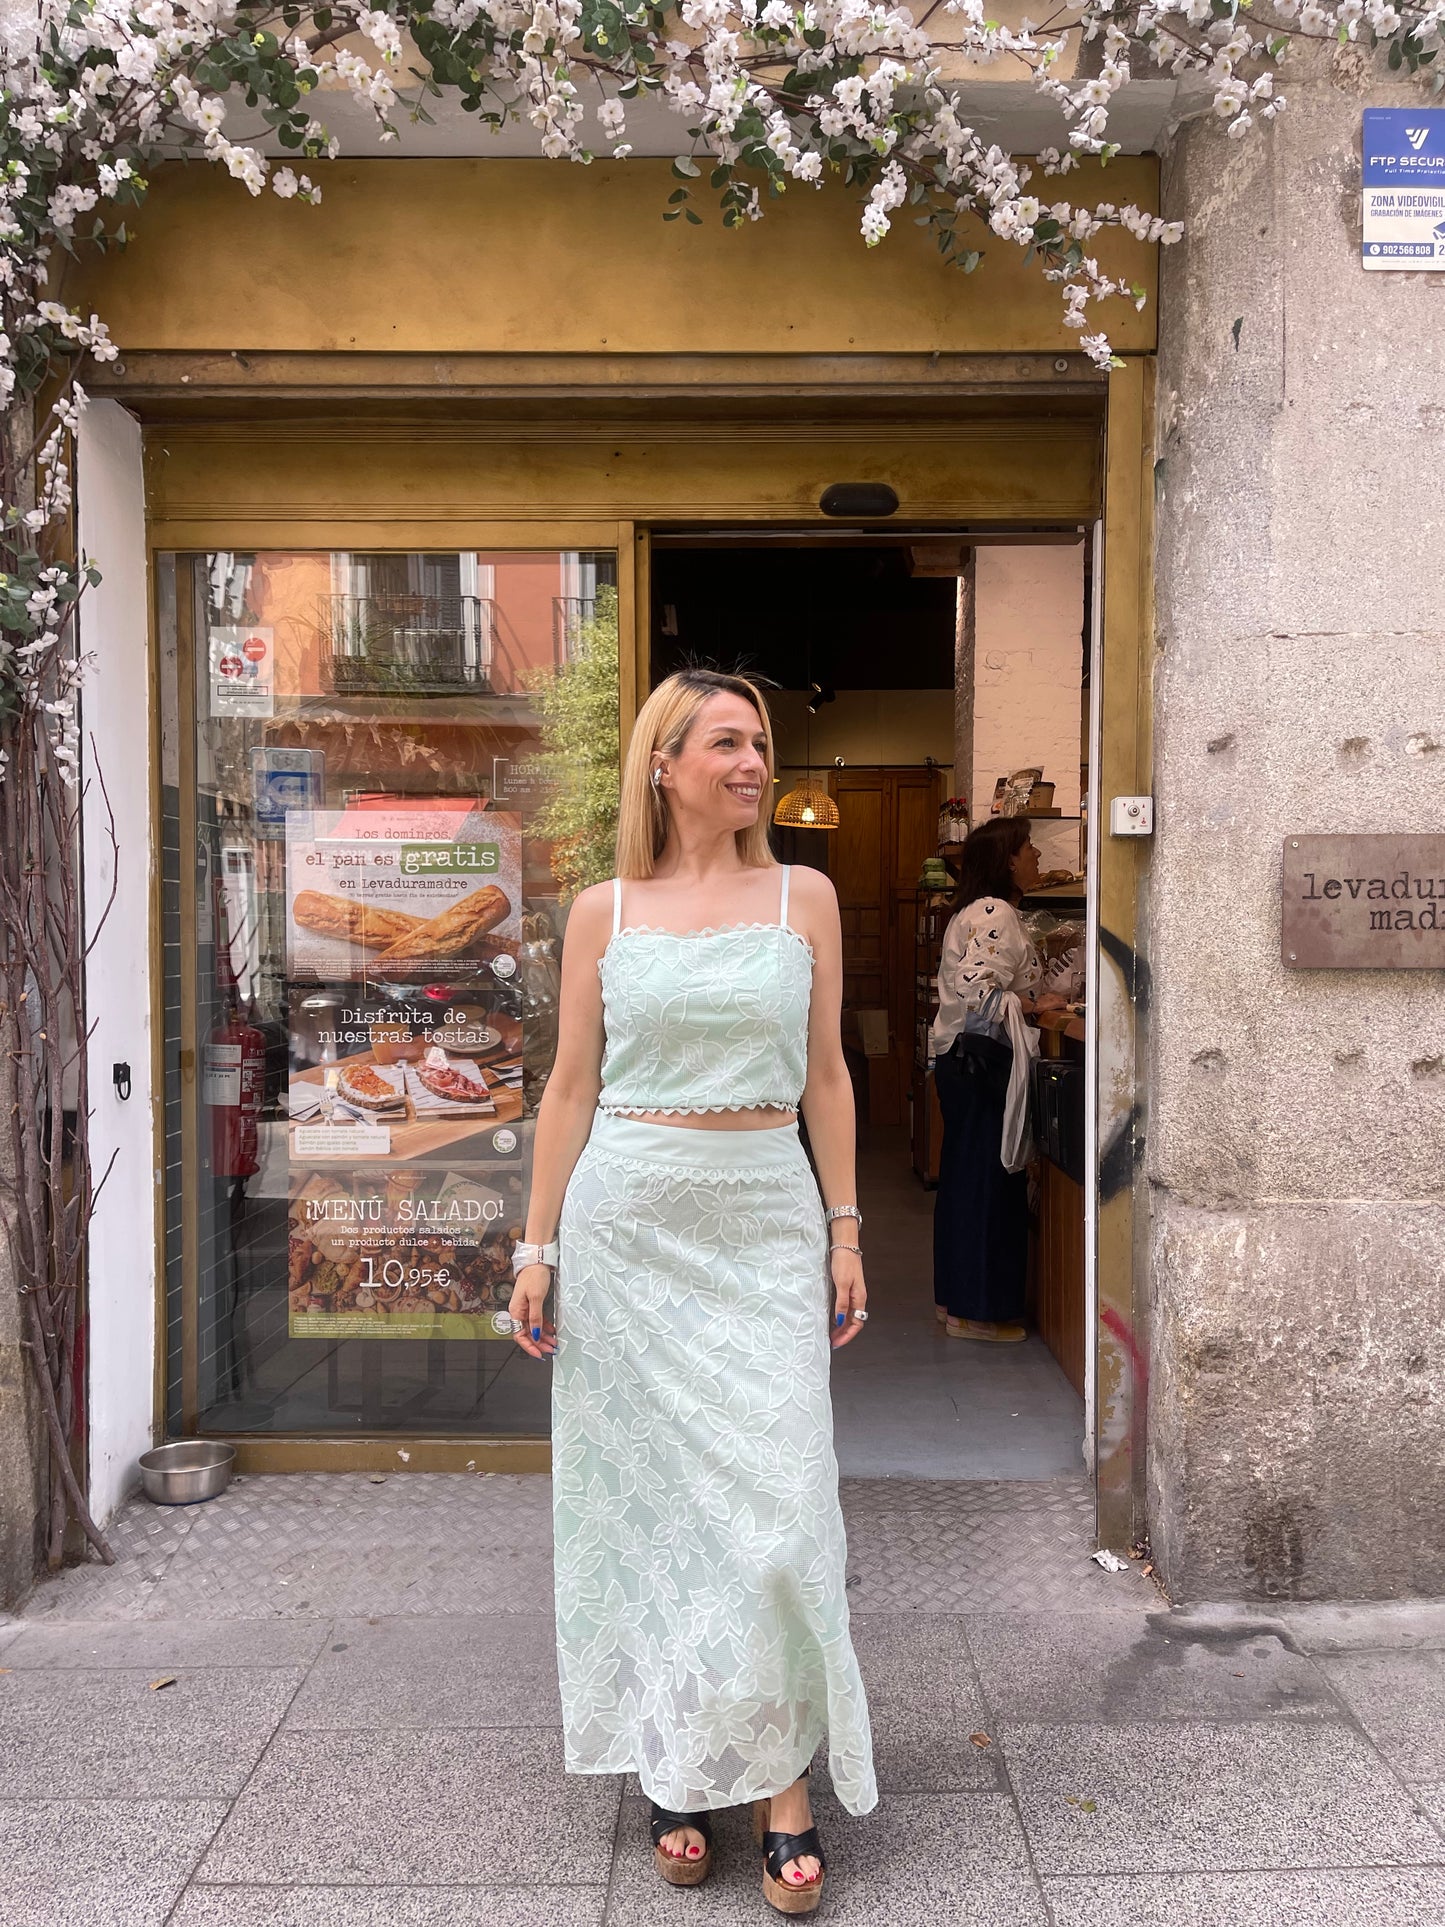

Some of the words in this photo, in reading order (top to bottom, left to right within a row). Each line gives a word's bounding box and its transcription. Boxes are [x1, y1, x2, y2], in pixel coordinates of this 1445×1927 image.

[1370, 156, 1396, 167] FTP
[1370, 195, 1395, 207] ZONA
[1370, 208, 1404, 217] GRABACIÓN
[1404, 209, 1413, 217] DE
[1413, 208, 1443, 218] IMÁGENES
[355, 828, 379, 840] Los
[305, 852, 326, 866] el
[332, 853, 367, 869] pan
[373, 854, 394, 866] es
[404, 846, 496, 874] gratis
[338, 880, 356, 889] en
[361, 877, 468, 889] Levaduramadre
[1369, 902, 1445, 931] mad
[340, 1008, 434, 1024] Disfruta
[443, 1007, 467, 1024] de
[317, 1027, 414, 1043] nuestras
[423, 1027, 490, 1043] tostas
[305, 1195, 384, 1221] ¡MENÚ
[396, 1199, 505, 1221] SALADO!
[340, 1225, 359, 1234] Dos
[362, 1225, 415, 1236] productos
[418, 1224, 462, 1234] salados
[349, 1237, 396, 1248] producto
[399, 1237, 430, 1246] dulce
[359, 1257, 451, 1290] 10,95€
